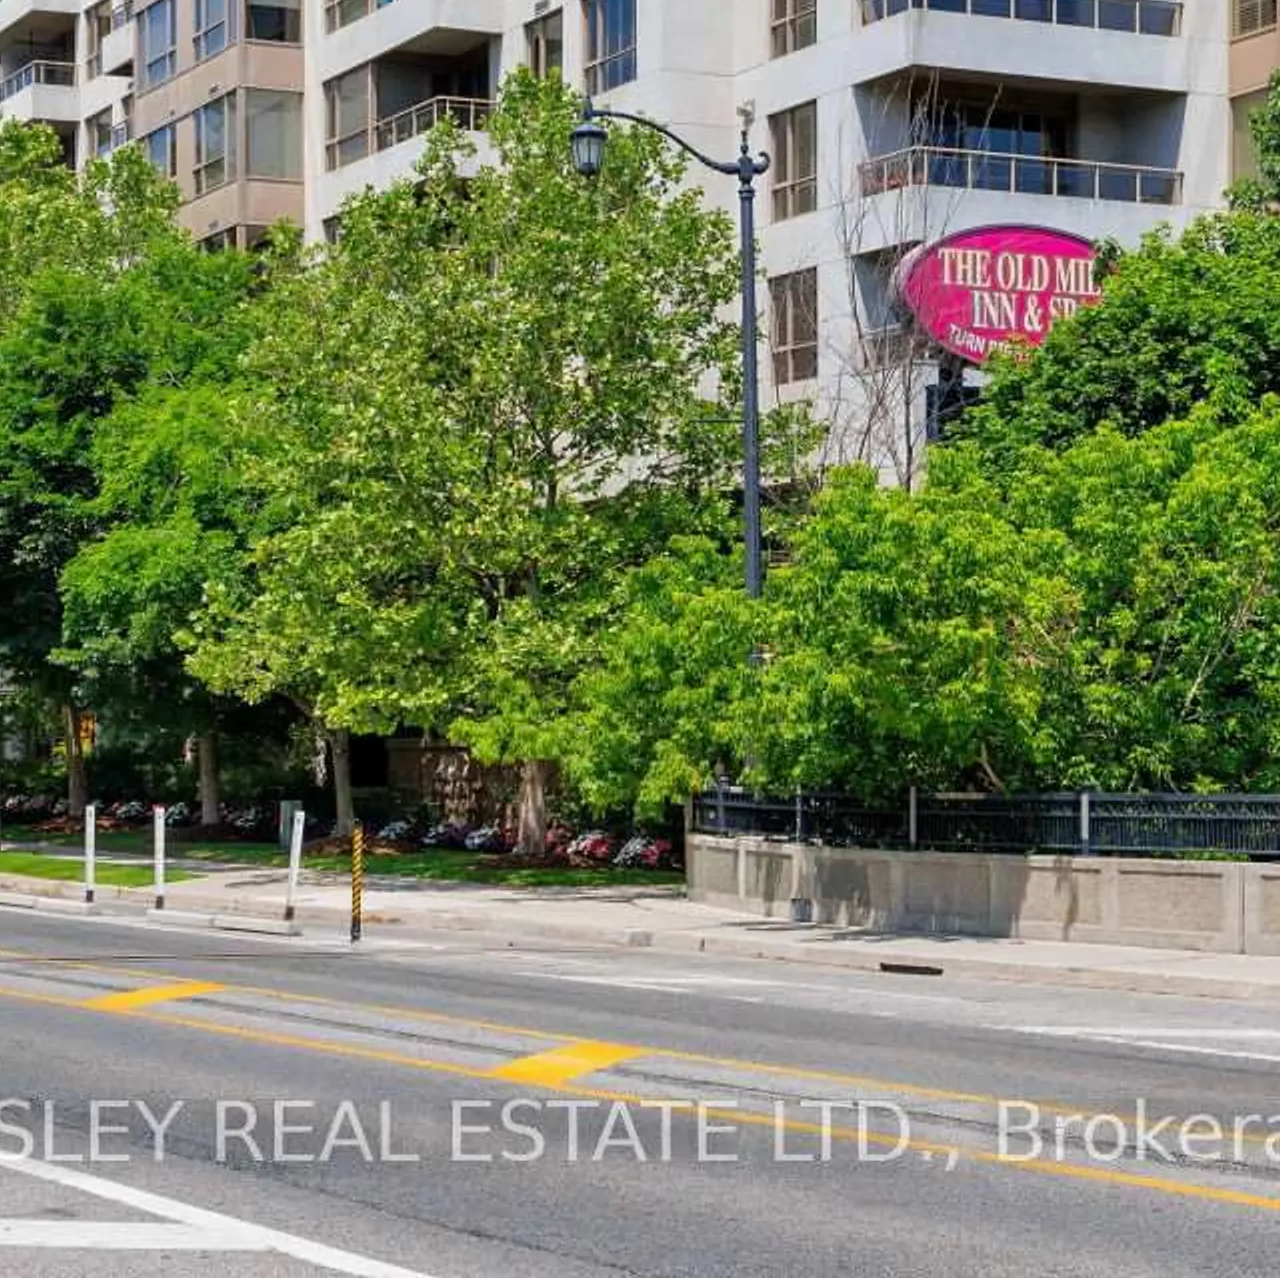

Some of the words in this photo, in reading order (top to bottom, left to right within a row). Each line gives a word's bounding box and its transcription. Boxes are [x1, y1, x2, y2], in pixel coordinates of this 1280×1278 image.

[938, 247, 991, 288] THE
[997, 252, 1050, 293] OLD
[1054, 257, 1101, 296] MIL
[972, 290, 1018, 329] INN
[1024, 293, 1042, 333] &
[1050, 297, 1077, 324] SP
[949, 323, 986, 354] TURN
